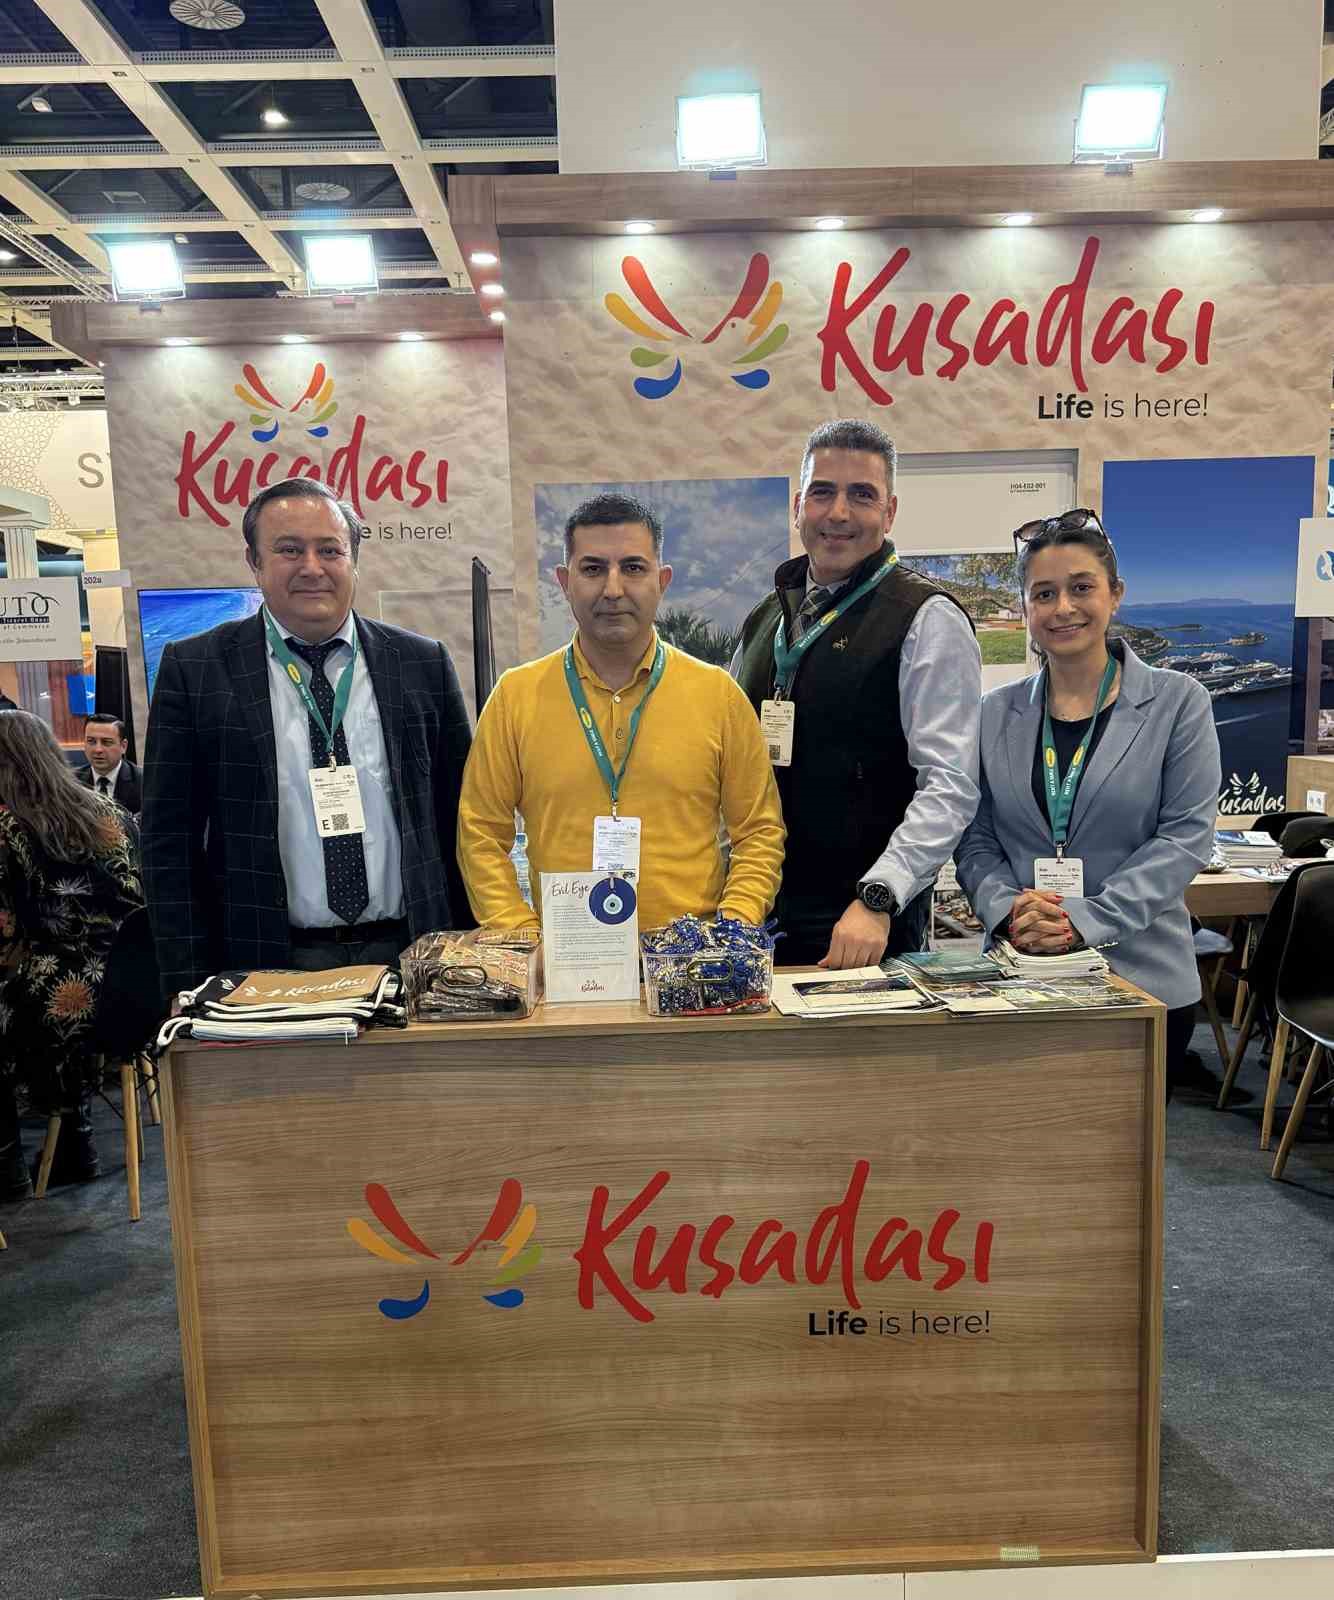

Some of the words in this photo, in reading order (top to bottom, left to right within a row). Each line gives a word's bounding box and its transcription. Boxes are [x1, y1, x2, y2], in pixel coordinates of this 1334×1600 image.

[1038, 394, 1094, 420] Life
[1104, 394, 1125, 419] is
[1134, 392, 1209, 418] here!
[378, 523, 394, 540] is
[400, 522, 453, 540] here!
[322, 819, 331, 831] E
[571, 880, 590, 898] Eye
[808, 1310, 869, 1336] Life
[879, 1310, 901, 1336] is
[912, 1309, 991, 1335] here!
